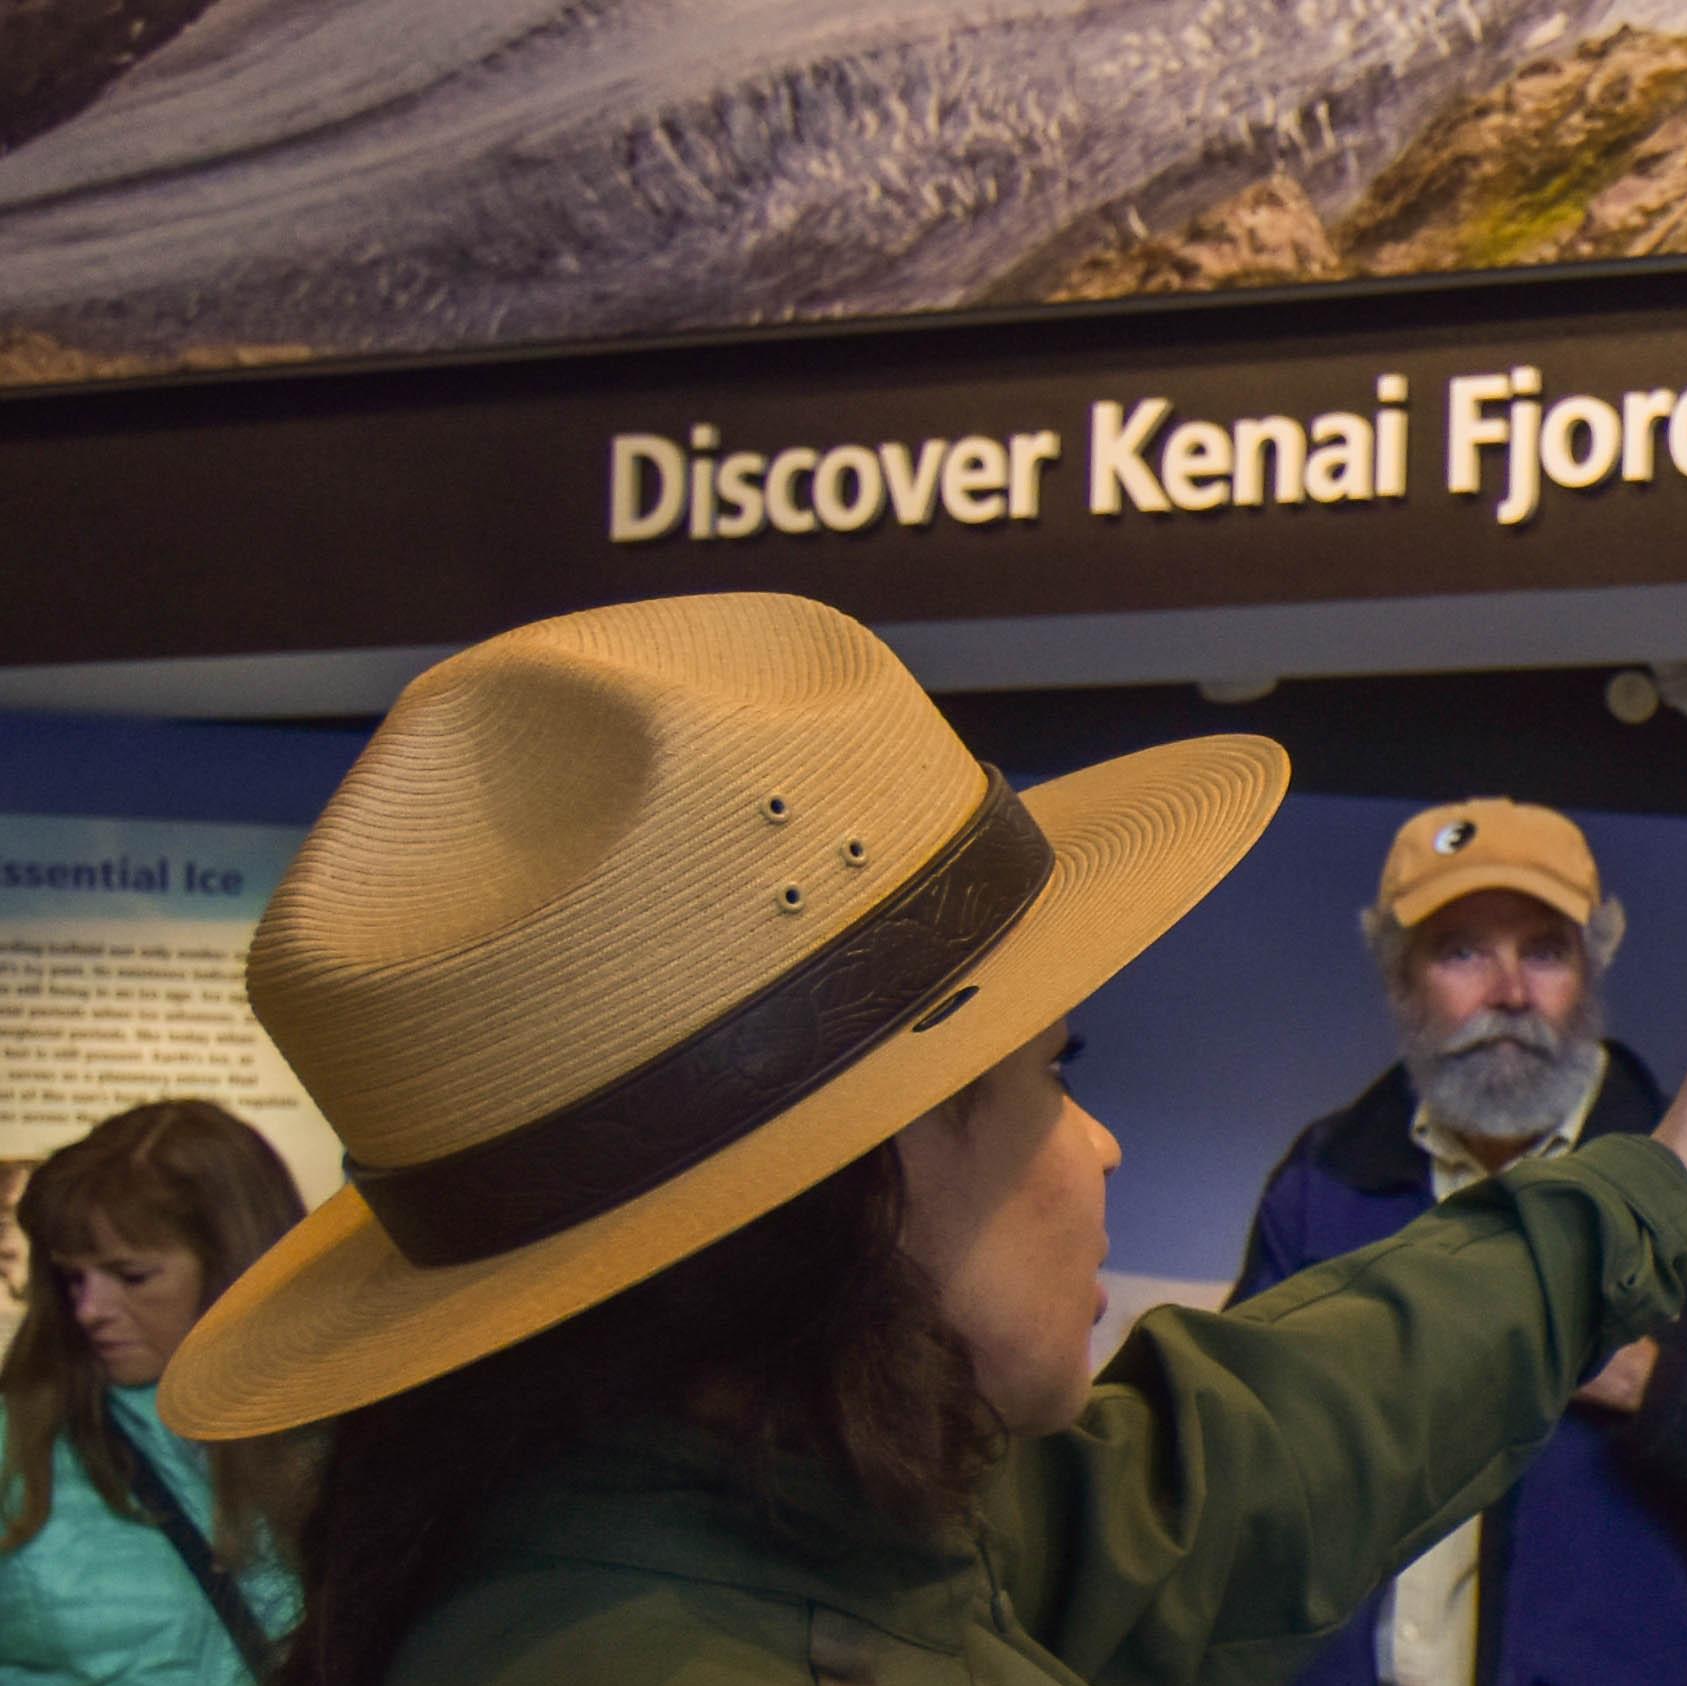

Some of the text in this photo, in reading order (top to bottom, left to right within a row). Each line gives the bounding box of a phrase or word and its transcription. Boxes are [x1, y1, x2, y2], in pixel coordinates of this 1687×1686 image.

[610, 422, 1060, 544] Discover
[1089, 372, 1409, 516] Kenai
[0, 856, 245, 896] ssential Ice
